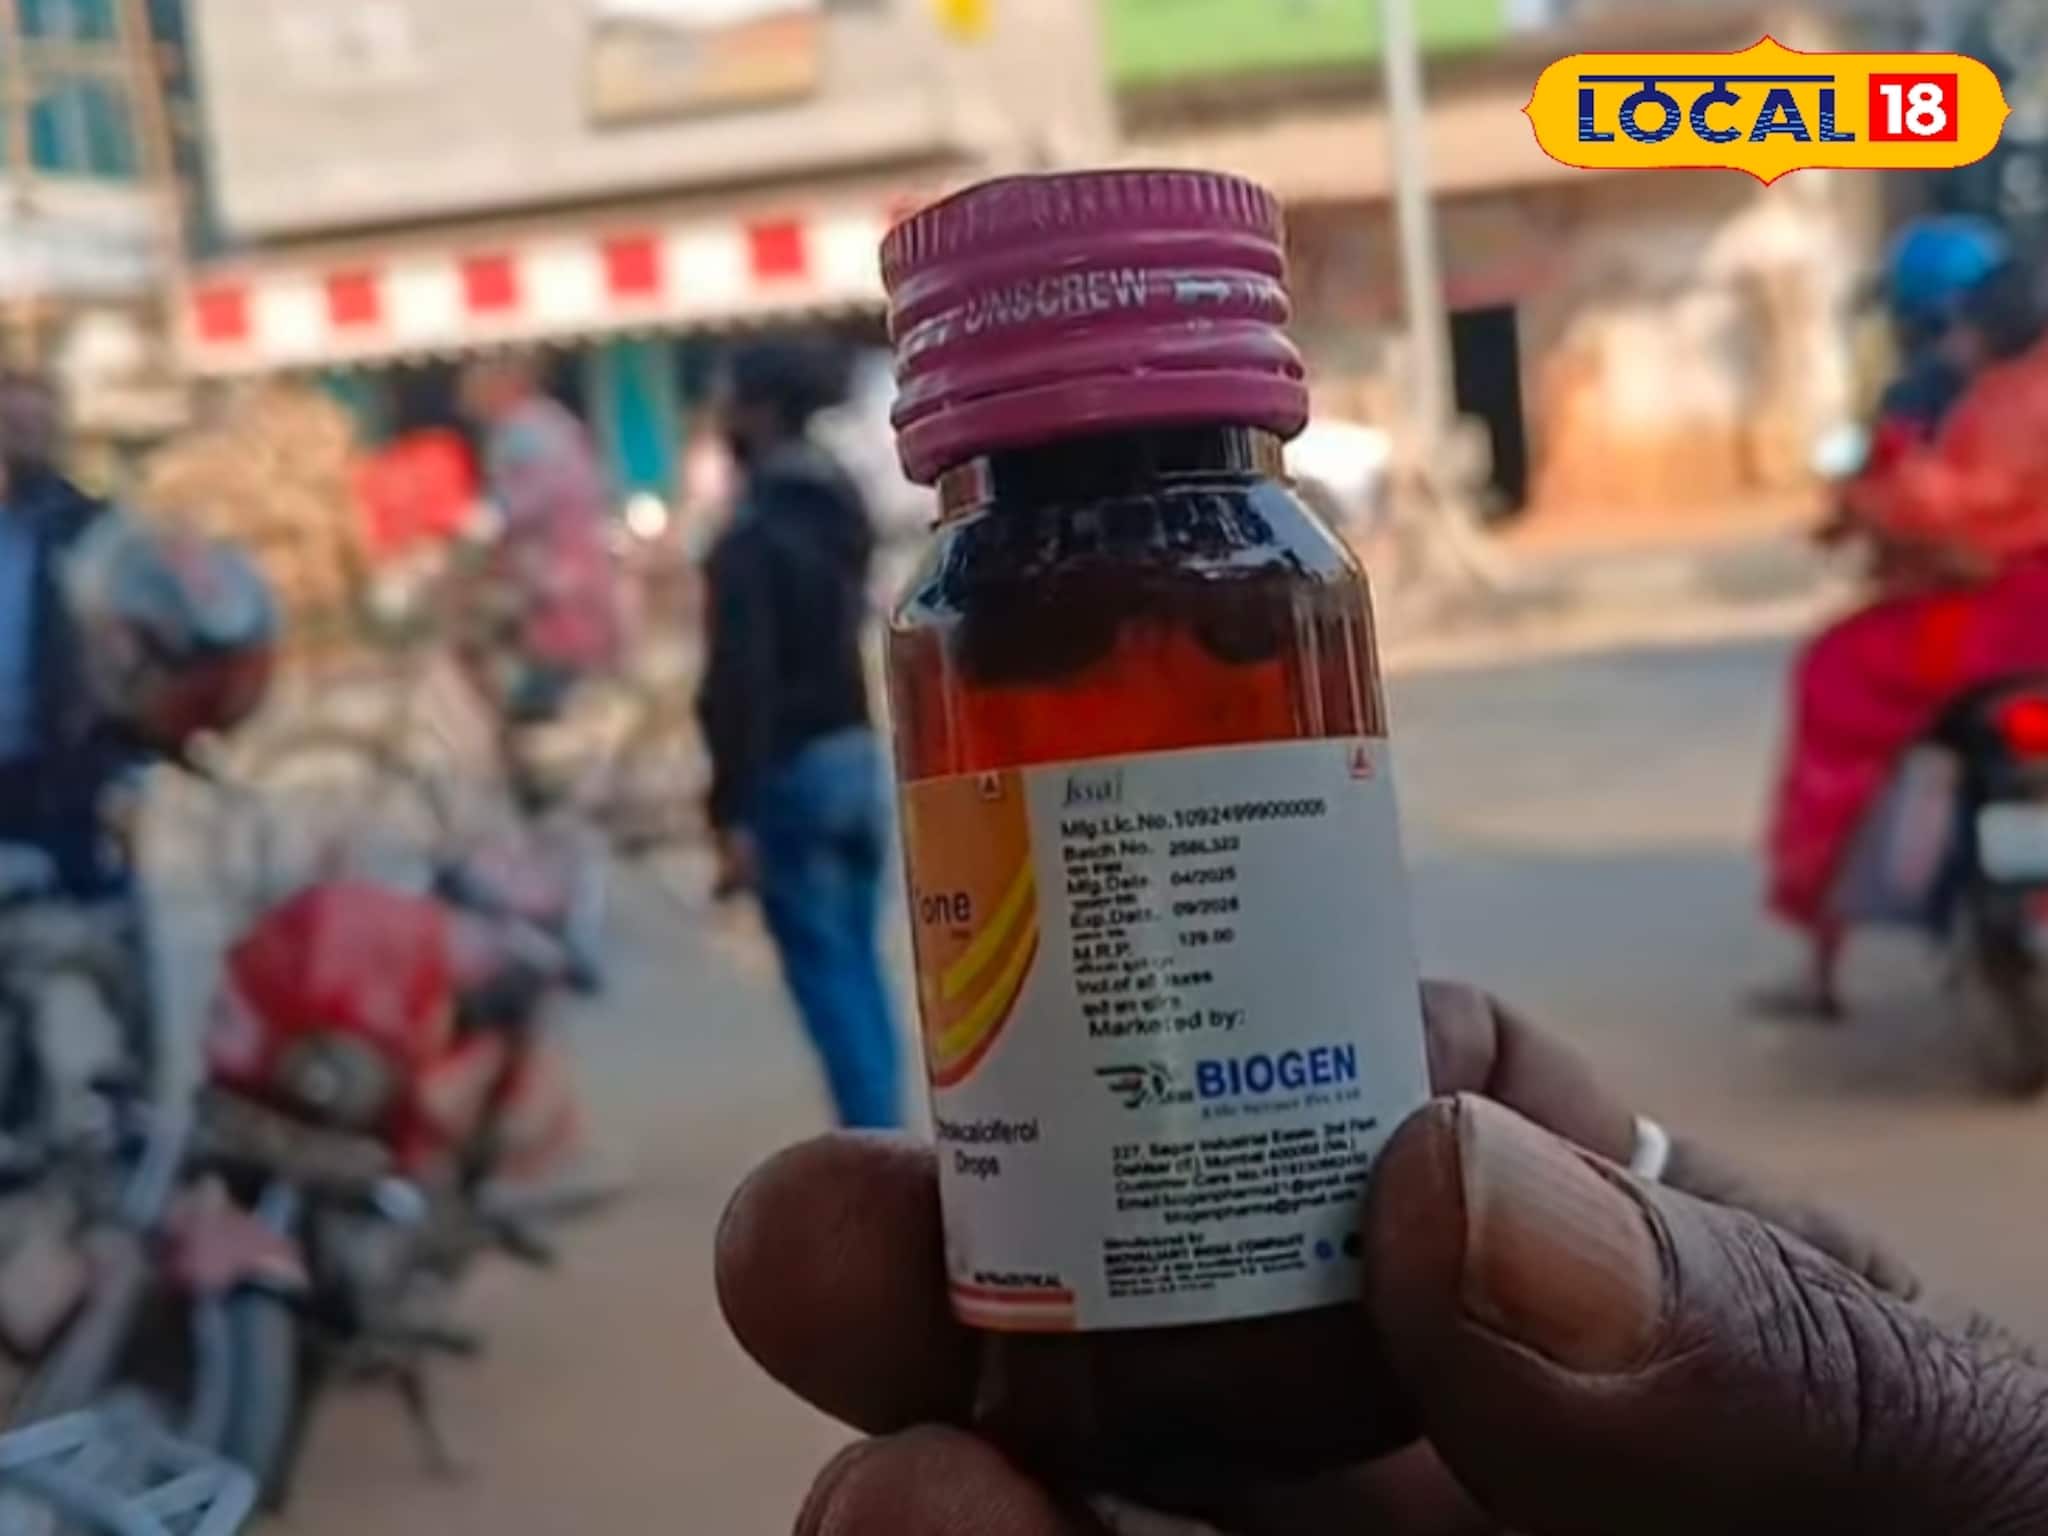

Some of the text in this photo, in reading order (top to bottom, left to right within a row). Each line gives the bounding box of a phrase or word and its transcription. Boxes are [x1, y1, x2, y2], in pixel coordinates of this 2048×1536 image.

[965, 267, 1147, 335] UNSCREW
[1194, 1043, 1357, 1099] BIOGEN
[955, 1149, 1001, 1182] Drops
